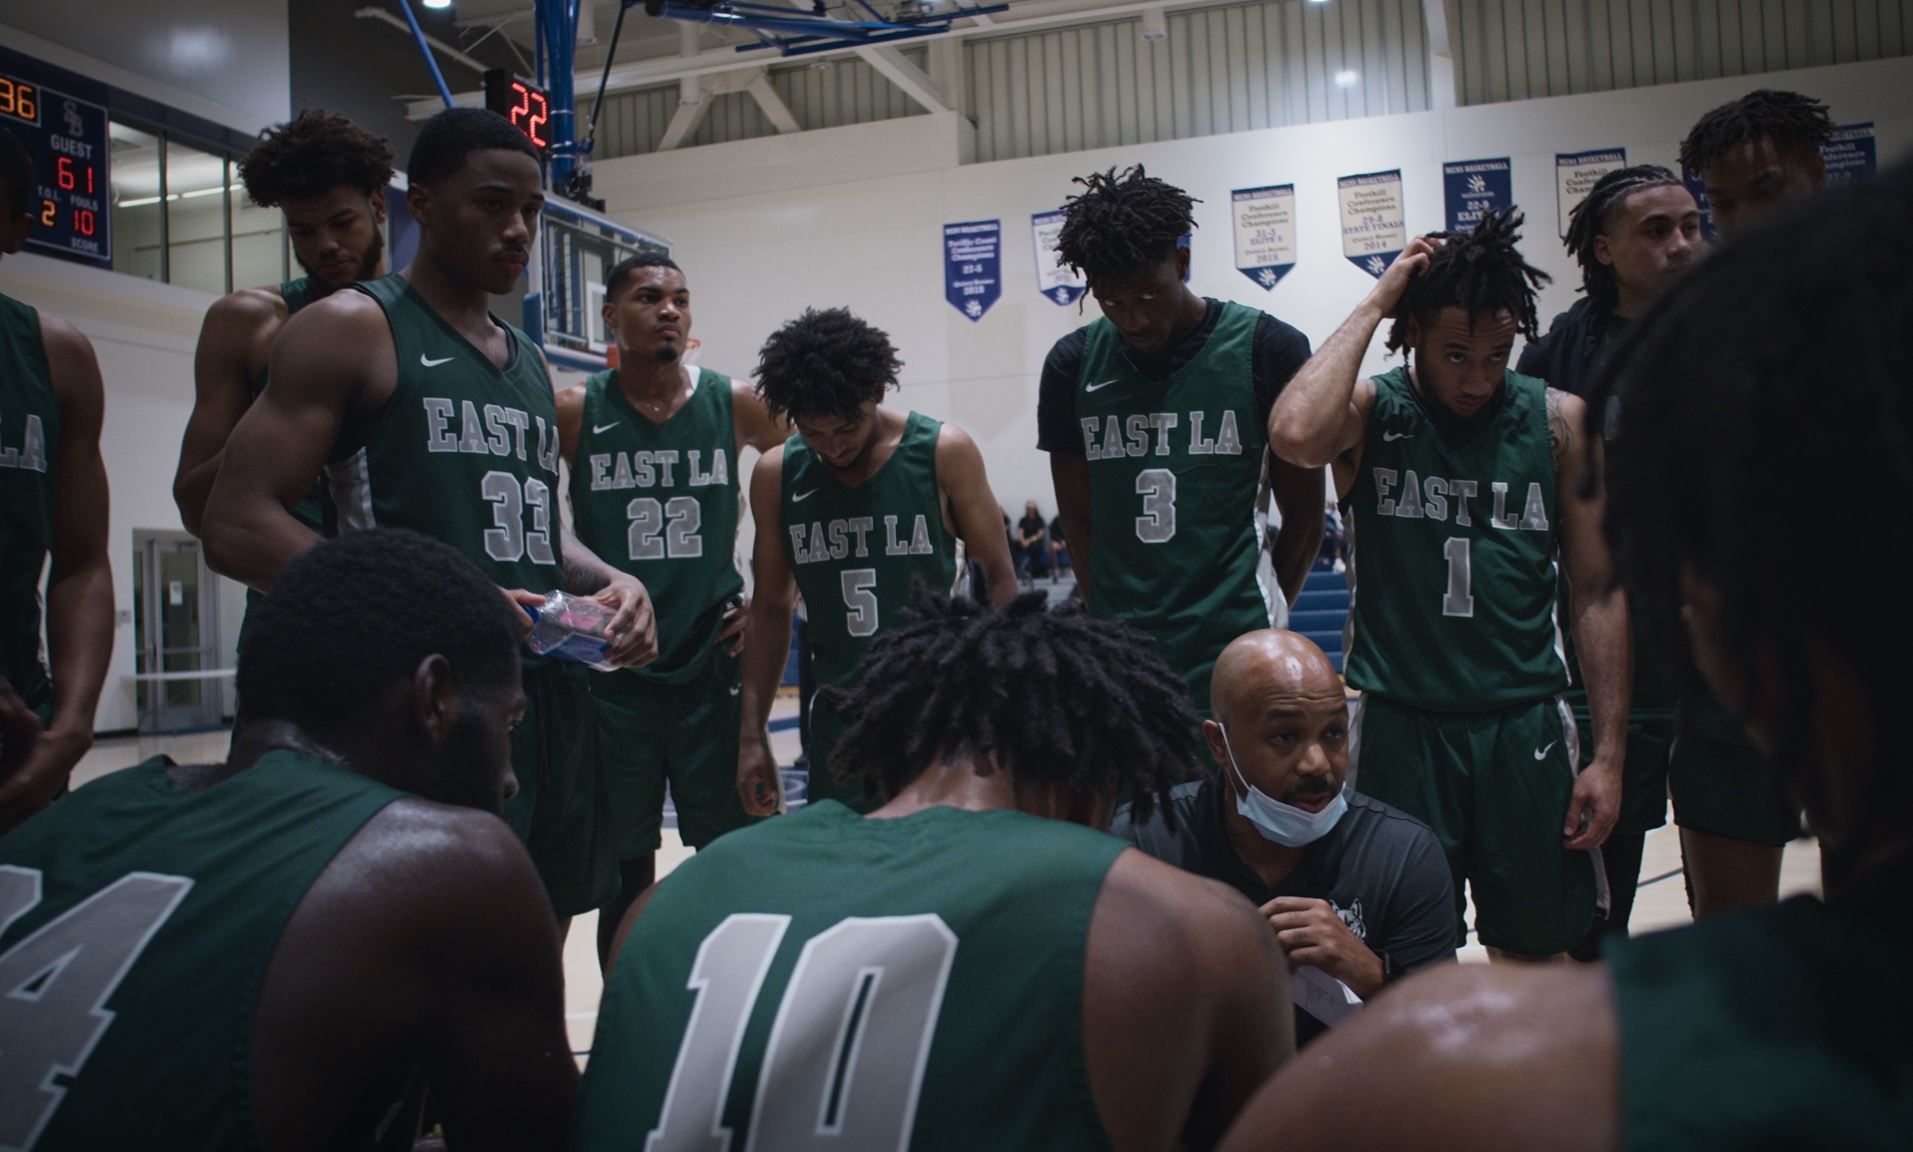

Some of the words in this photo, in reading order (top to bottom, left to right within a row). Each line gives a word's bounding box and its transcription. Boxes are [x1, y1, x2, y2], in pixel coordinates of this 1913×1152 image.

[511, 82, 548, 147] 22
[50, 134, 93, 160] GUEST
[56, 156, 95, 194] 61
[41, 199, 56, 228] 2
[70, 194, 99, 211] FOULS
[73, 208, 95, 237] 10
[1347, 197, 1395, 208] Conference
[1347, 205, 1396, 216] Champions
[1457, 210, 1484, 222] ELIT
[70, 236, 99, 254] SCORE
[423, 397, 529, 461] EAST
[1080, 412, 1178, 461] EAST
[1188, 410, 1243, 455] LA
[590, 449, 679, 490] EAST
[687, 448, 729, 486] LA
[481, 470, 556, 565] 33
[1135, 468, 1176, 543] 3
[1373, 467, 1478, 527] EAST
[1490, 482, 1549, 531] LA
[627, 496, 703, 561] 22
[789, 516, 874, 565] EAST
[884, 514, 933, 556] LA
[841, 567, 879, 637] 5
[1442, 536, 1474, 617] 1
[0, 864, 196, 1152] 4
[645, 913, 958, 1152] 10
